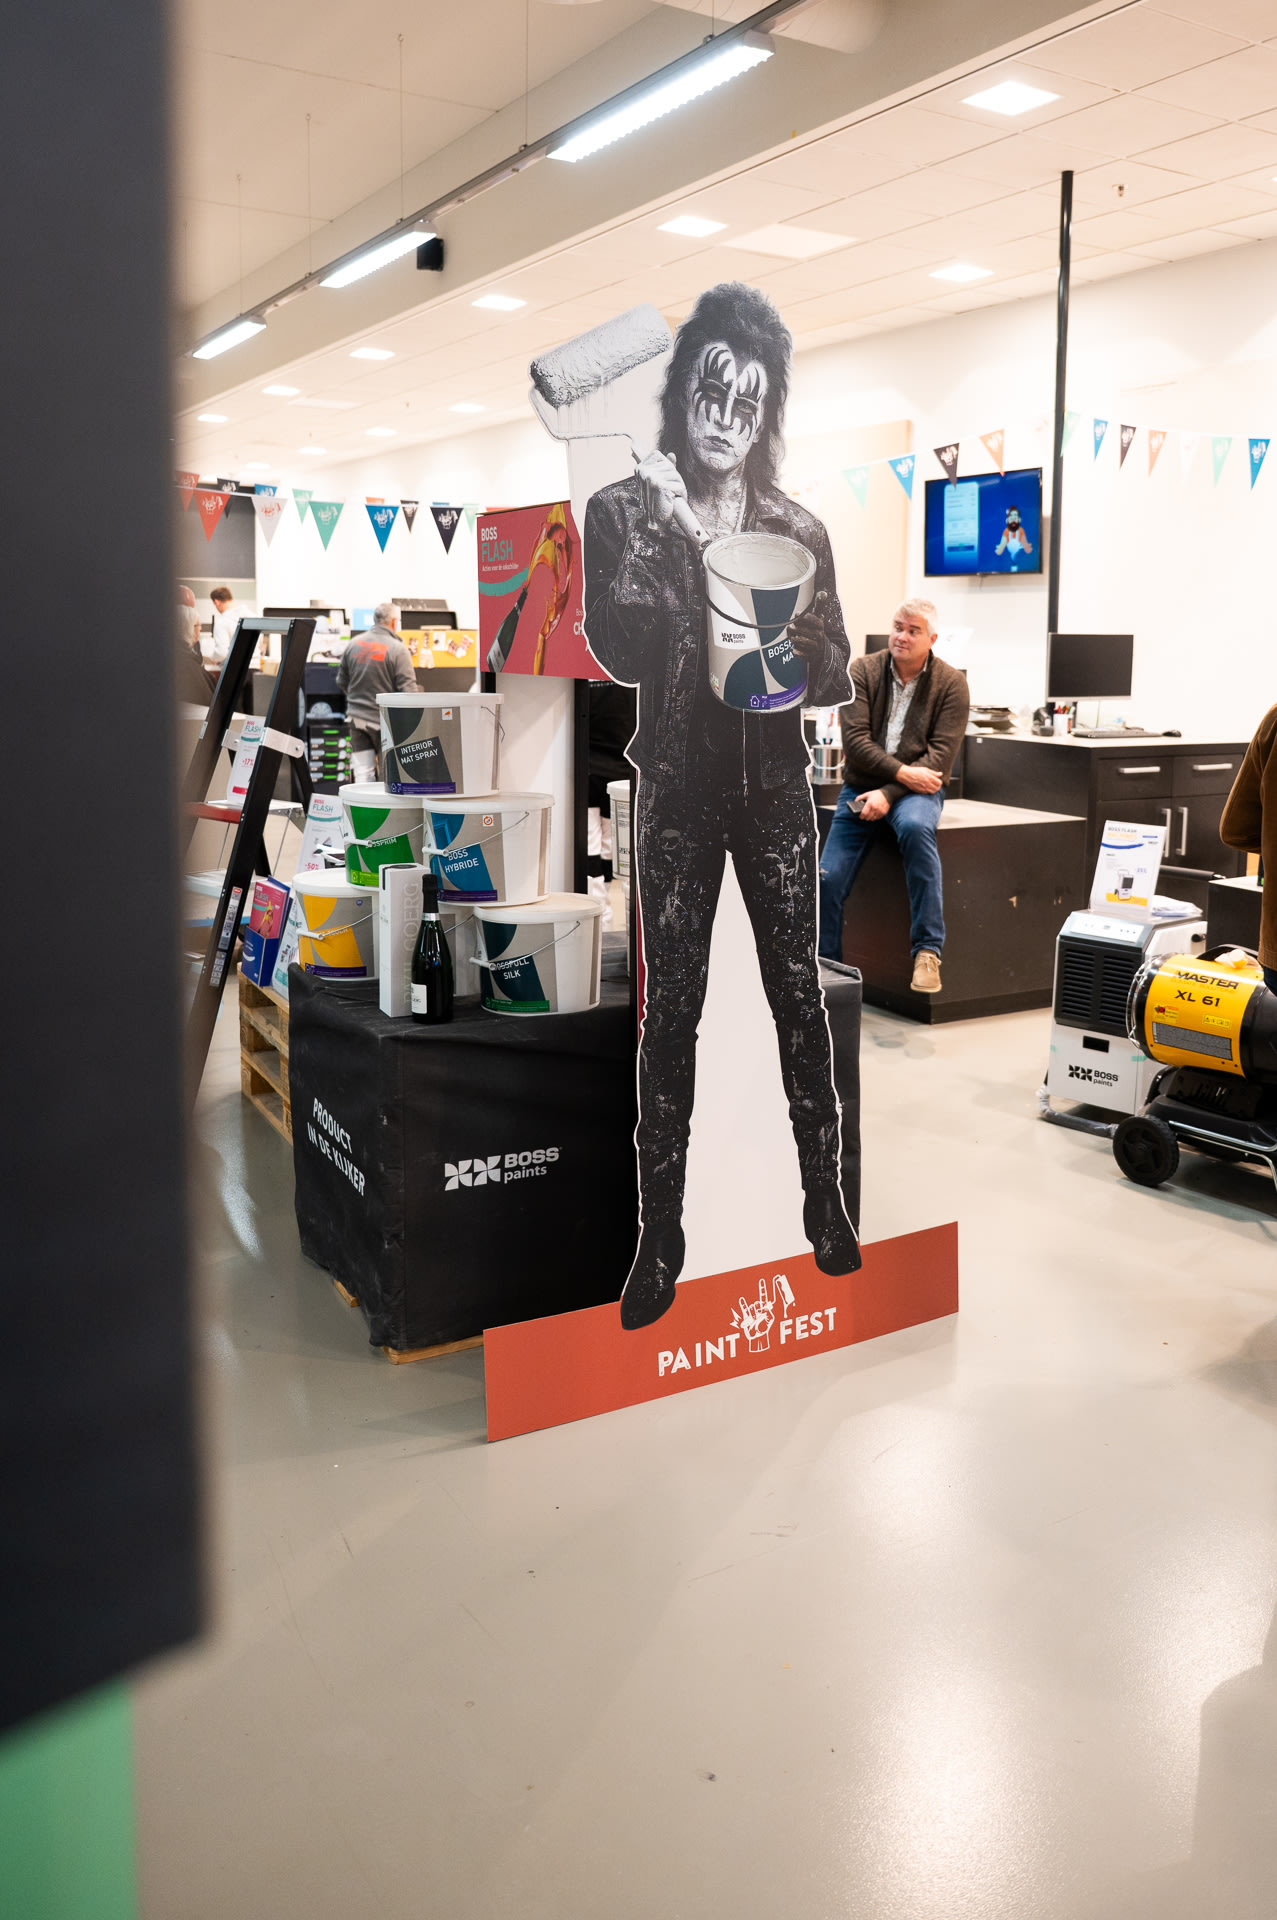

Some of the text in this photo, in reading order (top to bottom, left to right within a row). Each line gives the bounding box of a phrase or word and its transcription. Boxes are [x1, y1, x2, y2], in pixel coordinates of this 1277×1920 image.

[481, 526, 498, 541] BOSS
[481, 540, 513, 562] FLASH
[244, 725, 262, 733] FLASH
[400, 740, 434, 755] INTERIOR
[400, 748, 439, 765] MAT SPRAY
[312, 804, 333, 813] FLASH
[448, 849, 469, 861] BOSS
[304, 862, 320, 871] -50%
[444, 857, 480, 874] HYBRIDE
[494, 958, 530, 971] OSSFULL
[503, 969, 521, 980] SILK
[1176, 971, 1240, 990] MASTER
[1174, 989, 1220, 1008] XL 61
[1093, 1069, 1119, 1082] BOSS
[1093, 1078, 1113, 1087] paints
[313, 1097, 352, 1154] PRODUCT
[307, 1122, 366, 1197] IN DE KIJKER
[504, 1146, 560, 1169] BOSS
[504, 1164, 548, 1184] paints
[658, 1307, 837, 1377] PAINT FEST
